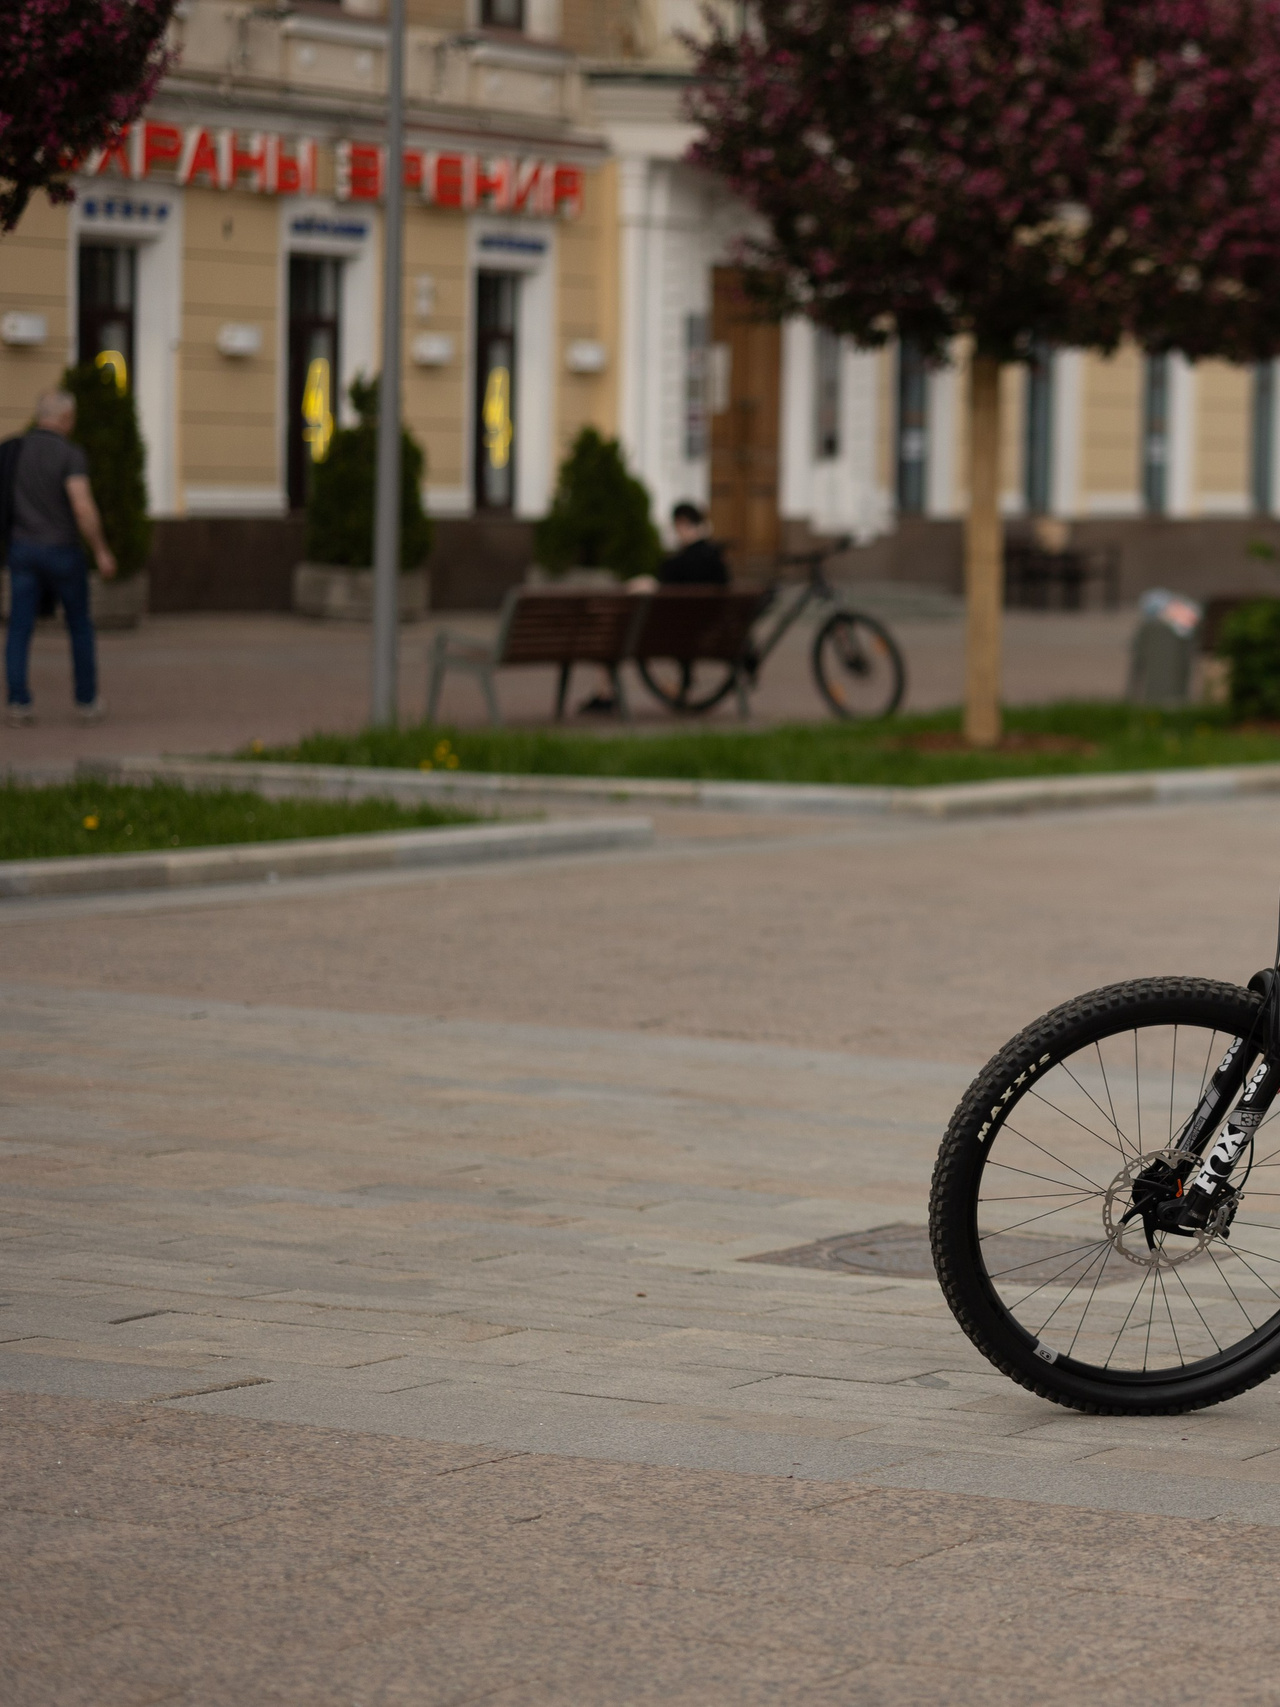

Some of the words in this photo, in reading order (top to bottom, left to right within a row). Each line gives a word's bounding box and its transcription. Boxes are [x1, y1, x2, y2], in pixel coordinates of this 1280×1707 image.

[57, 119, 318, 195] ХРАНЫ
[977, 1053, 1051, 1143] MAXXIS
[1194, 1121, 1248, 1196] FOX
